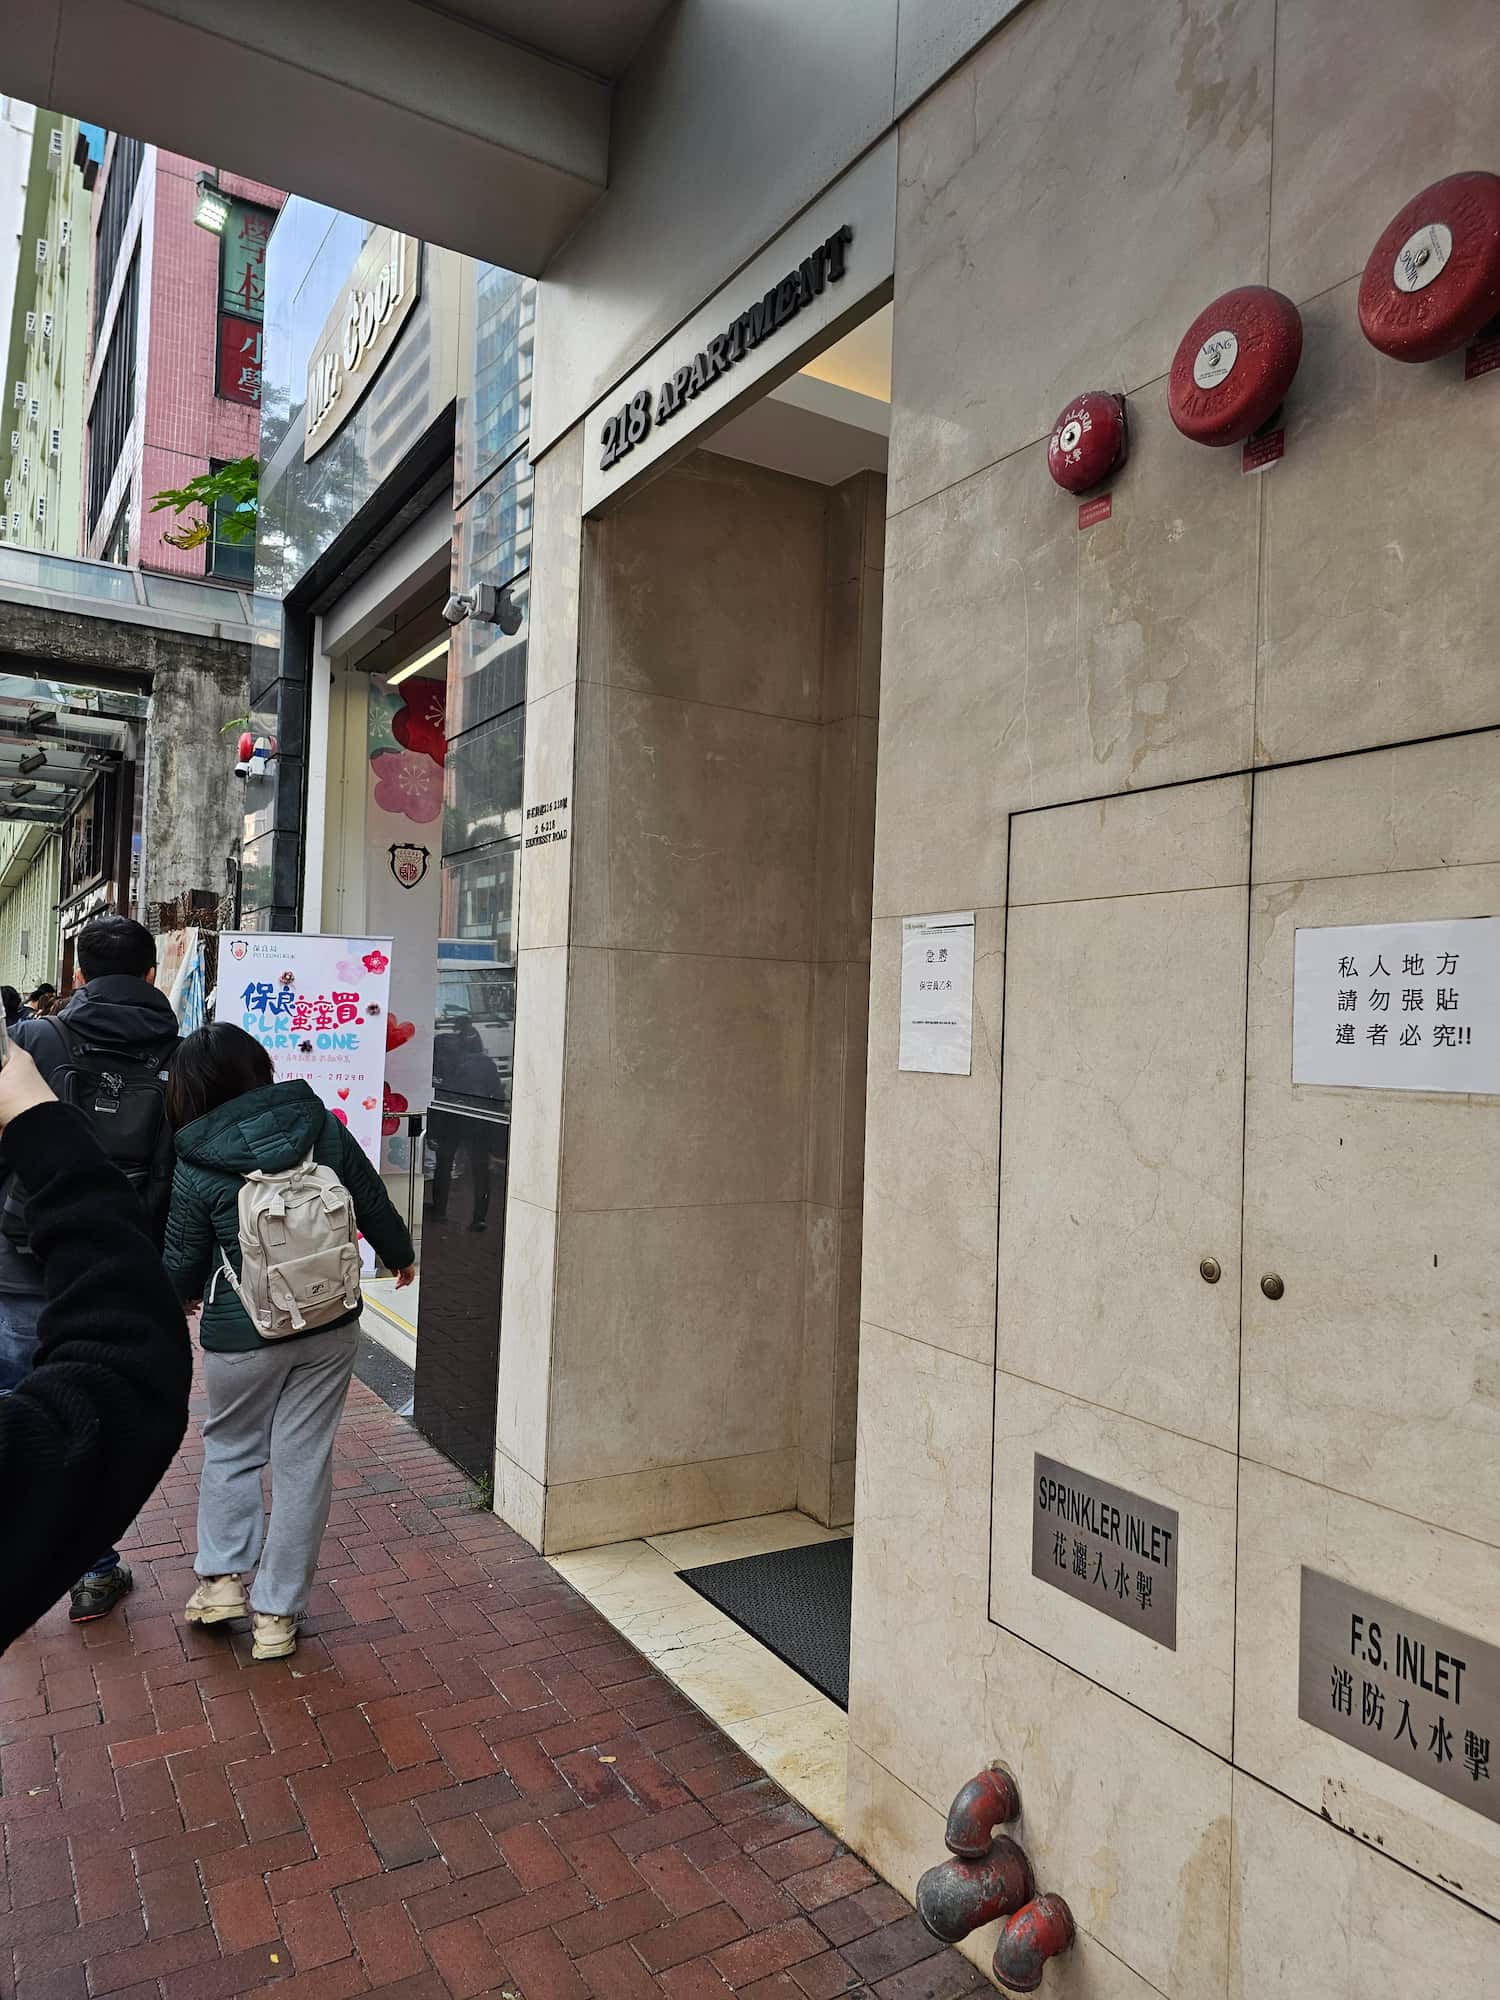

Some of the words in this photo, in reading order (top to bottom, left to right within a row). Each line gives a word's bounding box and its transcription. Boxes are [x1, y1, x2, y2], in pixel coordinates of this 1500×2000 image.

[1400, 250, 1418, 290] VIKING
[343, 232, 405, 373] Cool
[600, 390, 651, 471] 218
[655, 224, 852, 425] APARTMENT
[1201, 339, 1234, 356] VIKING
[1065, 408, 1092, 433] ALARM
[552, 829, 567, 841] ROAD
[1338, 951, 1460, 978] 私人地方
[1338, 987, 1460, 1012] 請勿張貼
[242, 1012, 289, 1033] PLK
[1335, 1023, 1472, 1048] 違者必究!!
[255, 1033, 300, 1051] ART
[317, 1033, 360, 1051] ONE
[1038, 1475, 1121, 1546] SPRINKLER
[1125, 1513, 1172, 1567] INLET
[1052, 1529, 1153, 1611] 花灑入水掣
[1351, 1612, 1388, 1672] F.S.
[1396, 1632, 1467, 1705] INLET
[1330, 1663, 1491, 1782] 消防入水掣
